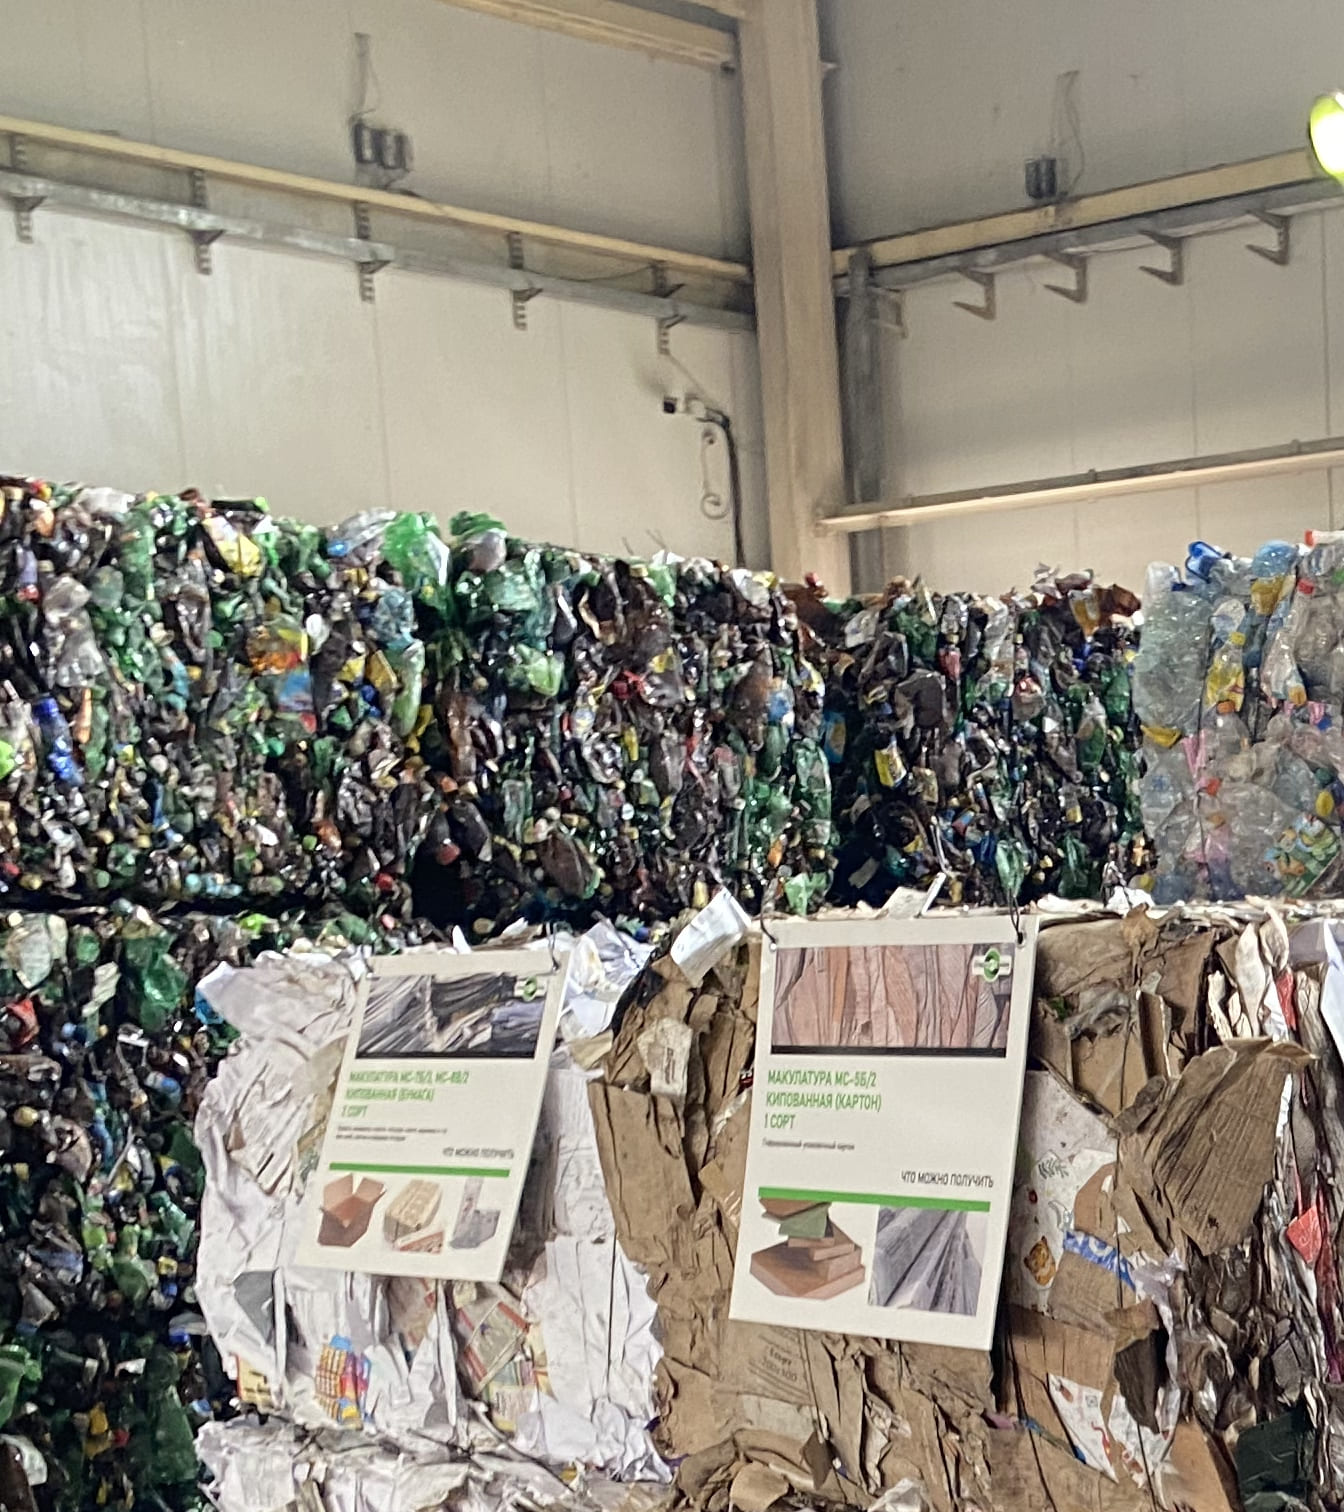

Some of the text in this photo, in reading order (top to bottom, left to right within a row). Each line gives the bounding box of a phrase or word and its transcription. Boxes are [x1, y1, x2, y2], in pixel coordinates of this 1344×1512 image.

[767, 1069, 832, 1086] МАКУЛАТУРА
[766, 1091, 882, 1112] КИПОВАННАЯ (КАРТОН)
[770, 1114, 796, 1129] СОРТ
[901, 1171, 994, 1188] ЧТО МОЖНО ПОЛУЧИТЬ
